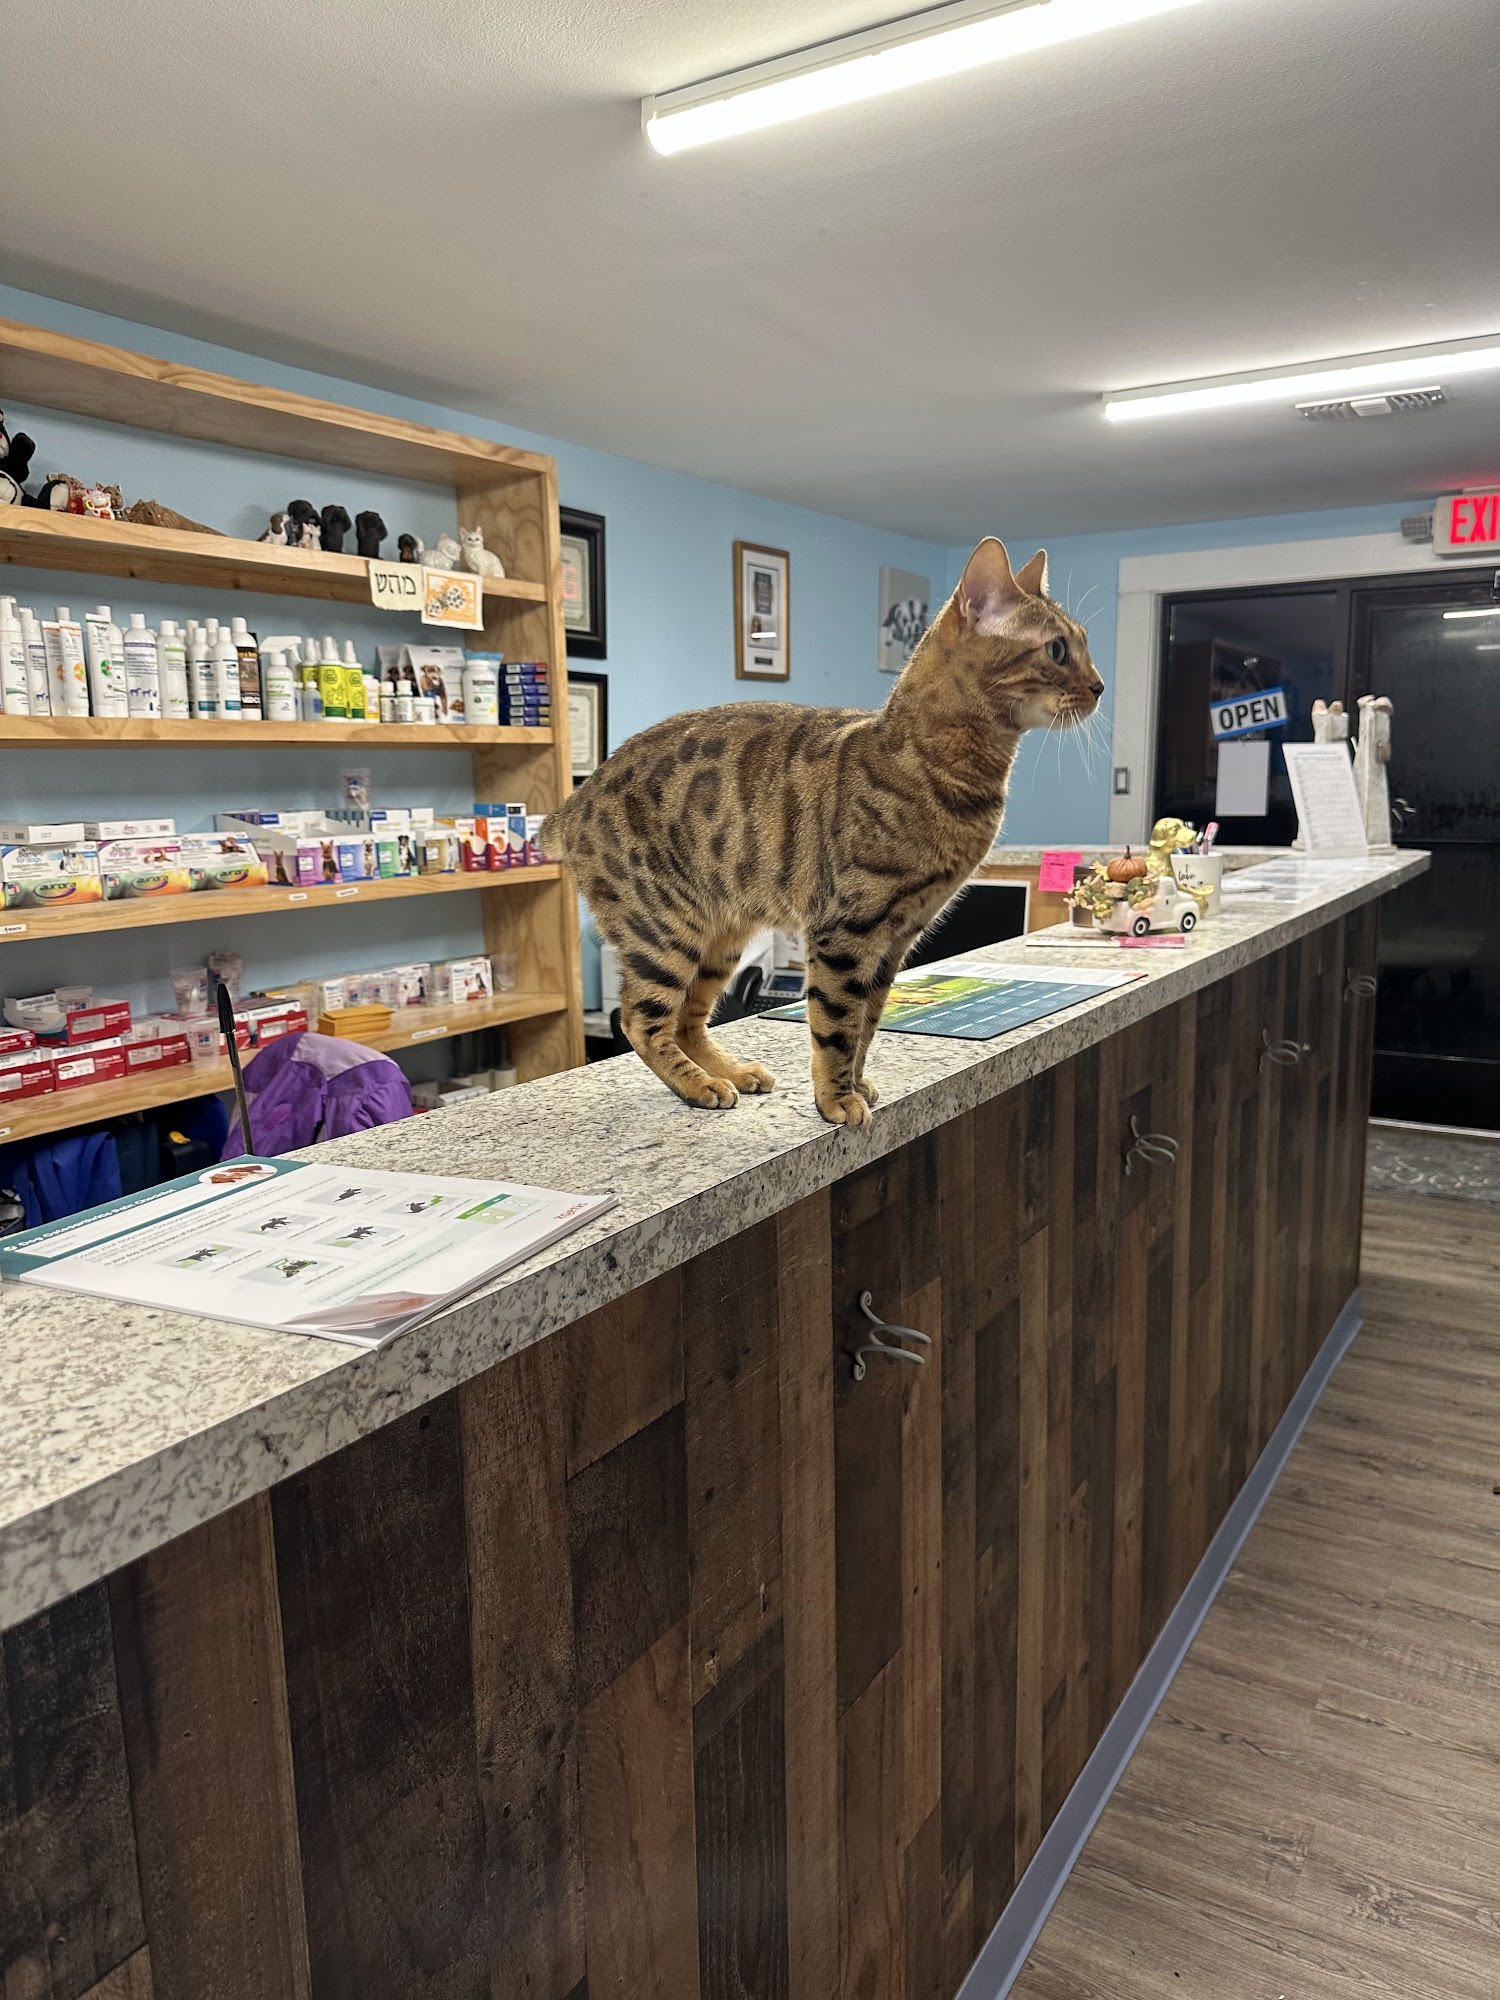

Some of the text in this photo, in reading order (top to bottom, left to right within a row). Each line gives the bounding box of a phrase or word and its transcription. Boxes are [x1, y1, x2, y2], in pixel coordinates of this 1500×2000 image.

[1449, 494, 1500, 545] EXI
[1219, 696, 1279, 731] OPEN
[219, 868, 250, 877] aurora
